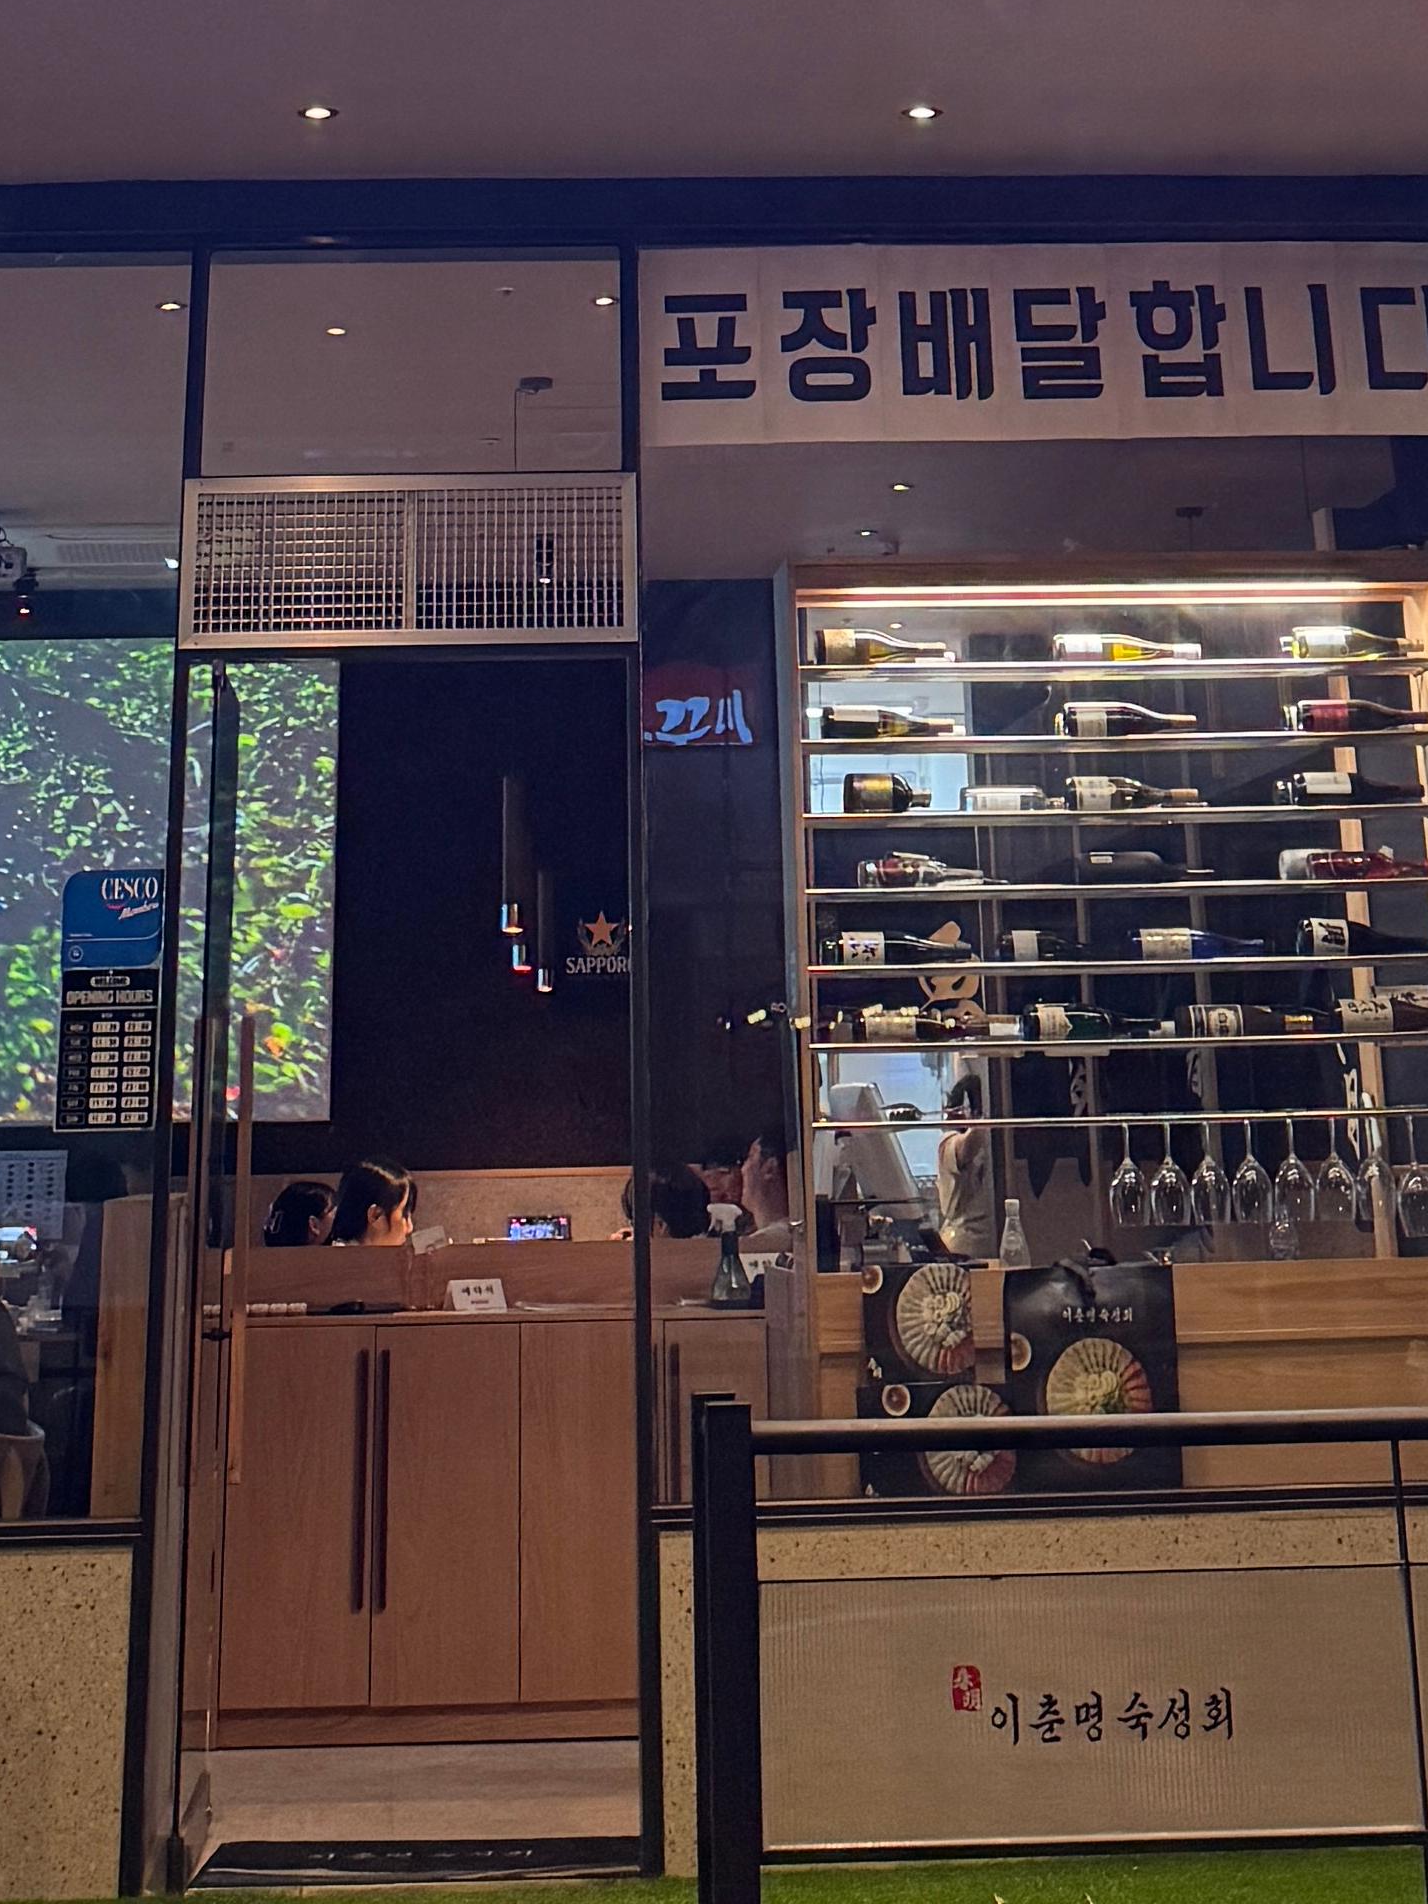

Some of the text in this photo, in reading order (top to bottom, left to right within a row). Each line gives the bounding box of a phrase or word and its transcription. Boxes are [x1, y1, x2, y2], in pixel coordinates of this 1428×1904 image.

[101, 877, 159, 900] CESCO
[66, 989, 154, 1005] OPENING HOURS
